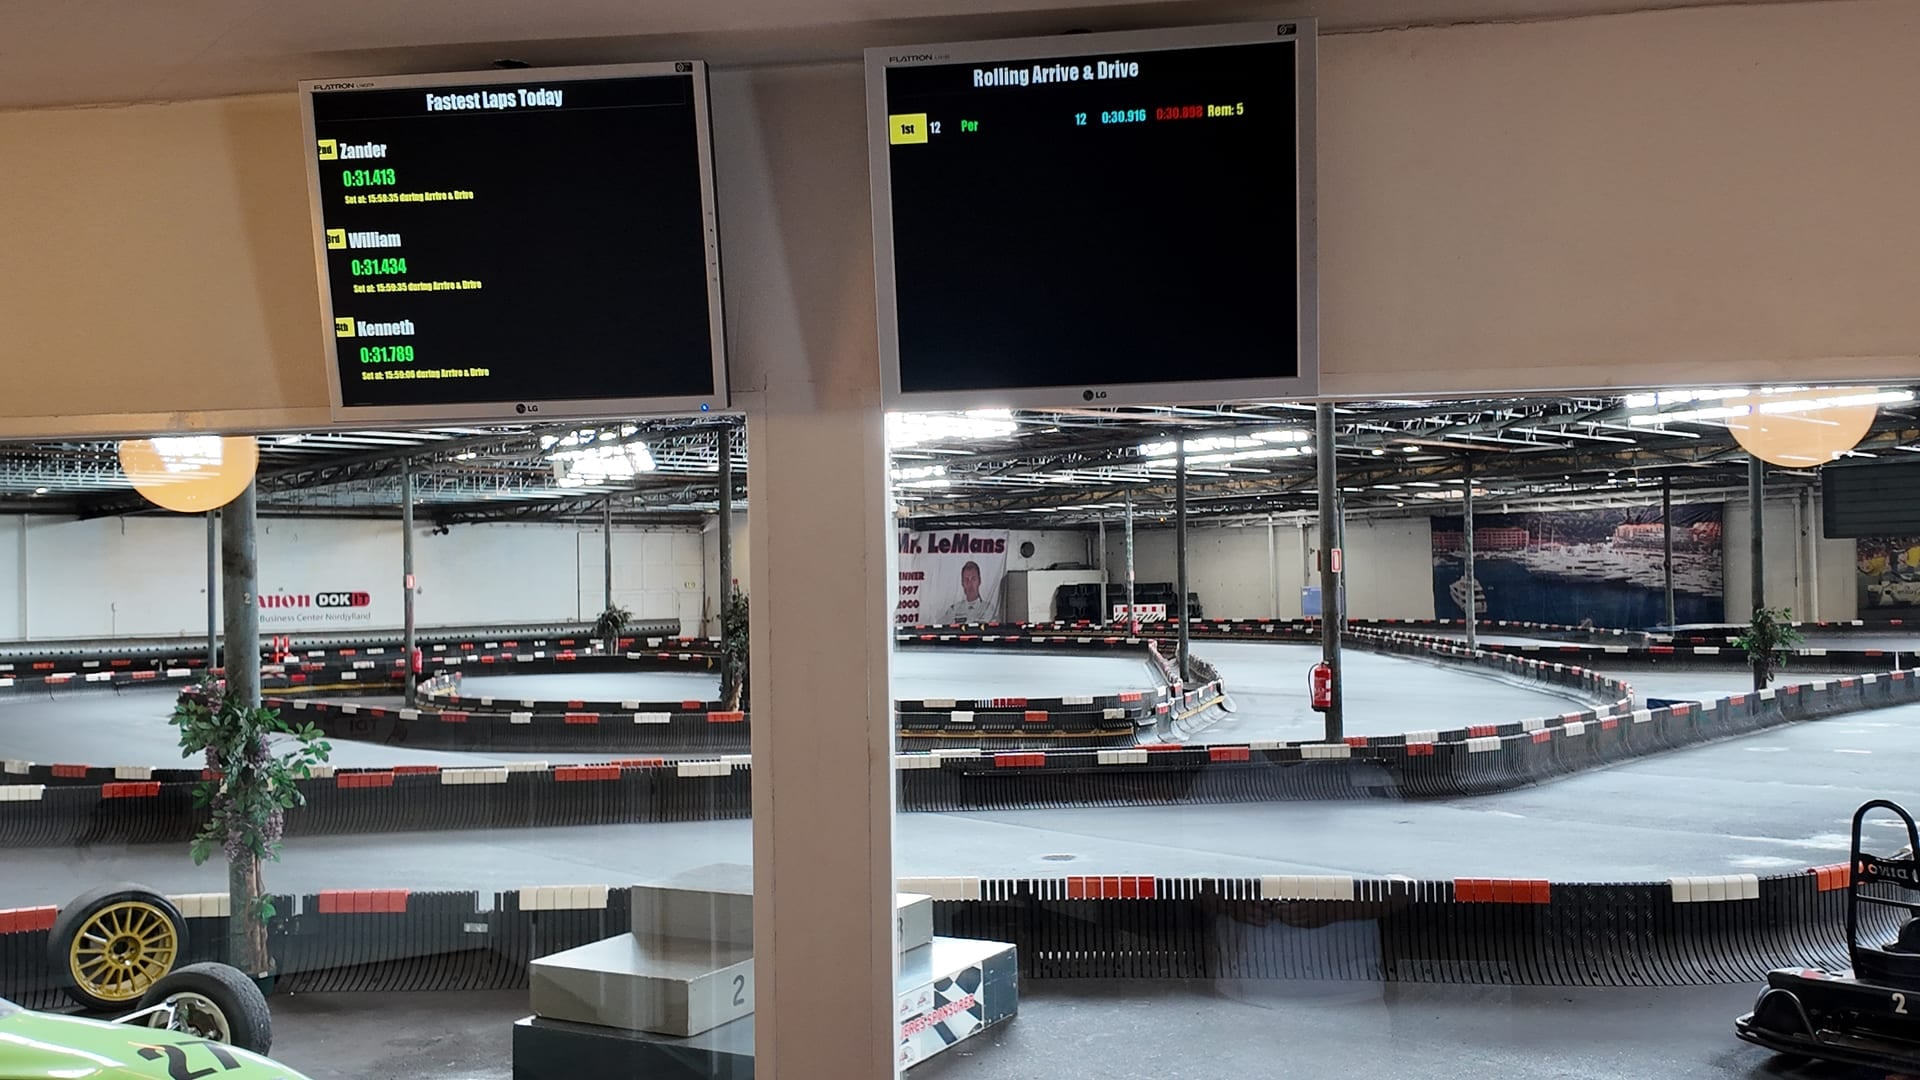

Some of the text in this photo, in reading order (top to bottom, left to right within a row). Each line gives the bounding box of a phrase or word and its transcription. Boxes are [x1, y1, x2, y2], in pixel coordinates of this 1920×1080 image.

[889, 54, 933, 63] FLATRON
[973, 60, 1139, 87] Rolling Arrive & Drive
[426, 88, 563, 111] Fastest Laps Today
[901, 123, 915, 134] 1st
[929, 121, 941, 134] 12
[1075, 112, 1087, 126] 12
[1101, 109, 1146, 124] 0:30.916
[1207, 104, 1234, 117] Rem:
[1236, 103, 1244, 116] 5
[339, 142, 387, 159] Zander
[343, 169, 396, 187] 0:31.413
[345, 195, 357, 204] Set
[358, 194, 367, 204] at:
[400, 192, 424, 202] during
[425, 191, 447, 201] Arrive
[448, 192, 453, 200] &
[454, 190, 474, 200] Drive
[348, 231, 402, 249] William
[351, 258, 407, 276] 0:31.434
[353, 284, 366, 293] Set
[366, 283, 376, 293] at:
[408, 281, 433, 291] during
[433, 281, 455, 291] Arrive
[462, 280, 482, 289] Drive
[357, 319, 415, 337] Kenneth
[360, 345, 414, 363] 0:31.789
[362, 371, 374, 380] Set
[375, 370, 385, 380] at:
[416, 369, 440, 379] during
[441, 368, 463, 378] Arrive
[464, 369, 469, 377] &
[470, 367, 490, 377] Drive
[898, 533, 1005, 554] Mr. LeMans
[899, 571, 924, 580] INNER
[244, 592, 251, 604] 2
[258, 595, 310, 608] anon
[260, 611, 371, 623] Business Center Nordjylland
[895, 613, 919, 623] 2001
[733, 974, 744, 1006] 2
[1892, 993, 1908, 1014] 2
[137, 1040, 241, 1080] 27
